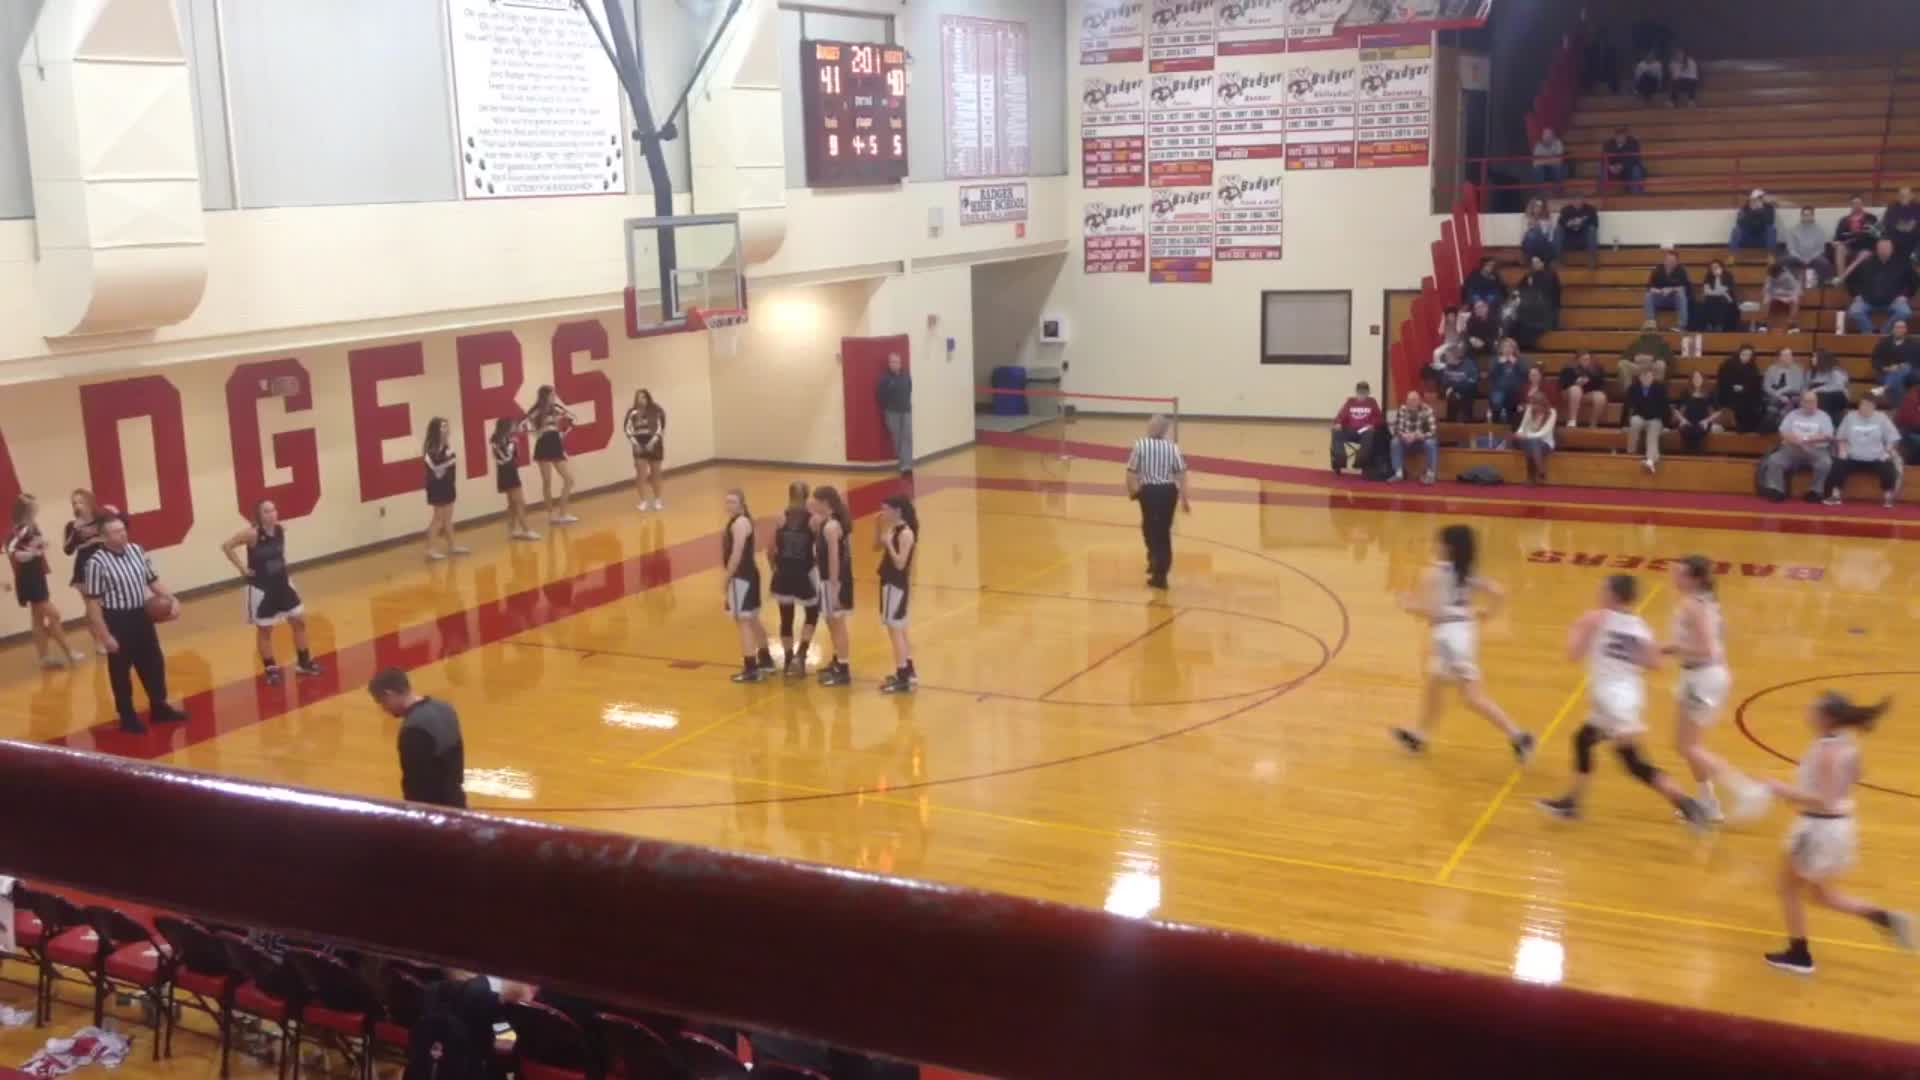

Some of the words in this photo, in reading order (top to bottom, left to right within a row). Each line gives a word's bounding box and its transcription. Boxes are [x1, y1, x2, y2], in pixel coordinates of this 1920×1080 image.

[821, 65, 841, 94] 41
[1241, 73, 1282, 90] Badger
[1311, 68, 1354, 86] Badger
[1386, 64, 1429, 82] Badger
[887, 69, 904, 96] 40
[1104, 80, 1143, 96] Badger
[1172, 76, 1212, 94] Badger
[1241, 176, 1281, 192] Badger
[1172, 190, 1211, 205] Badger
[1105, 203, 1143, 219] Badger
